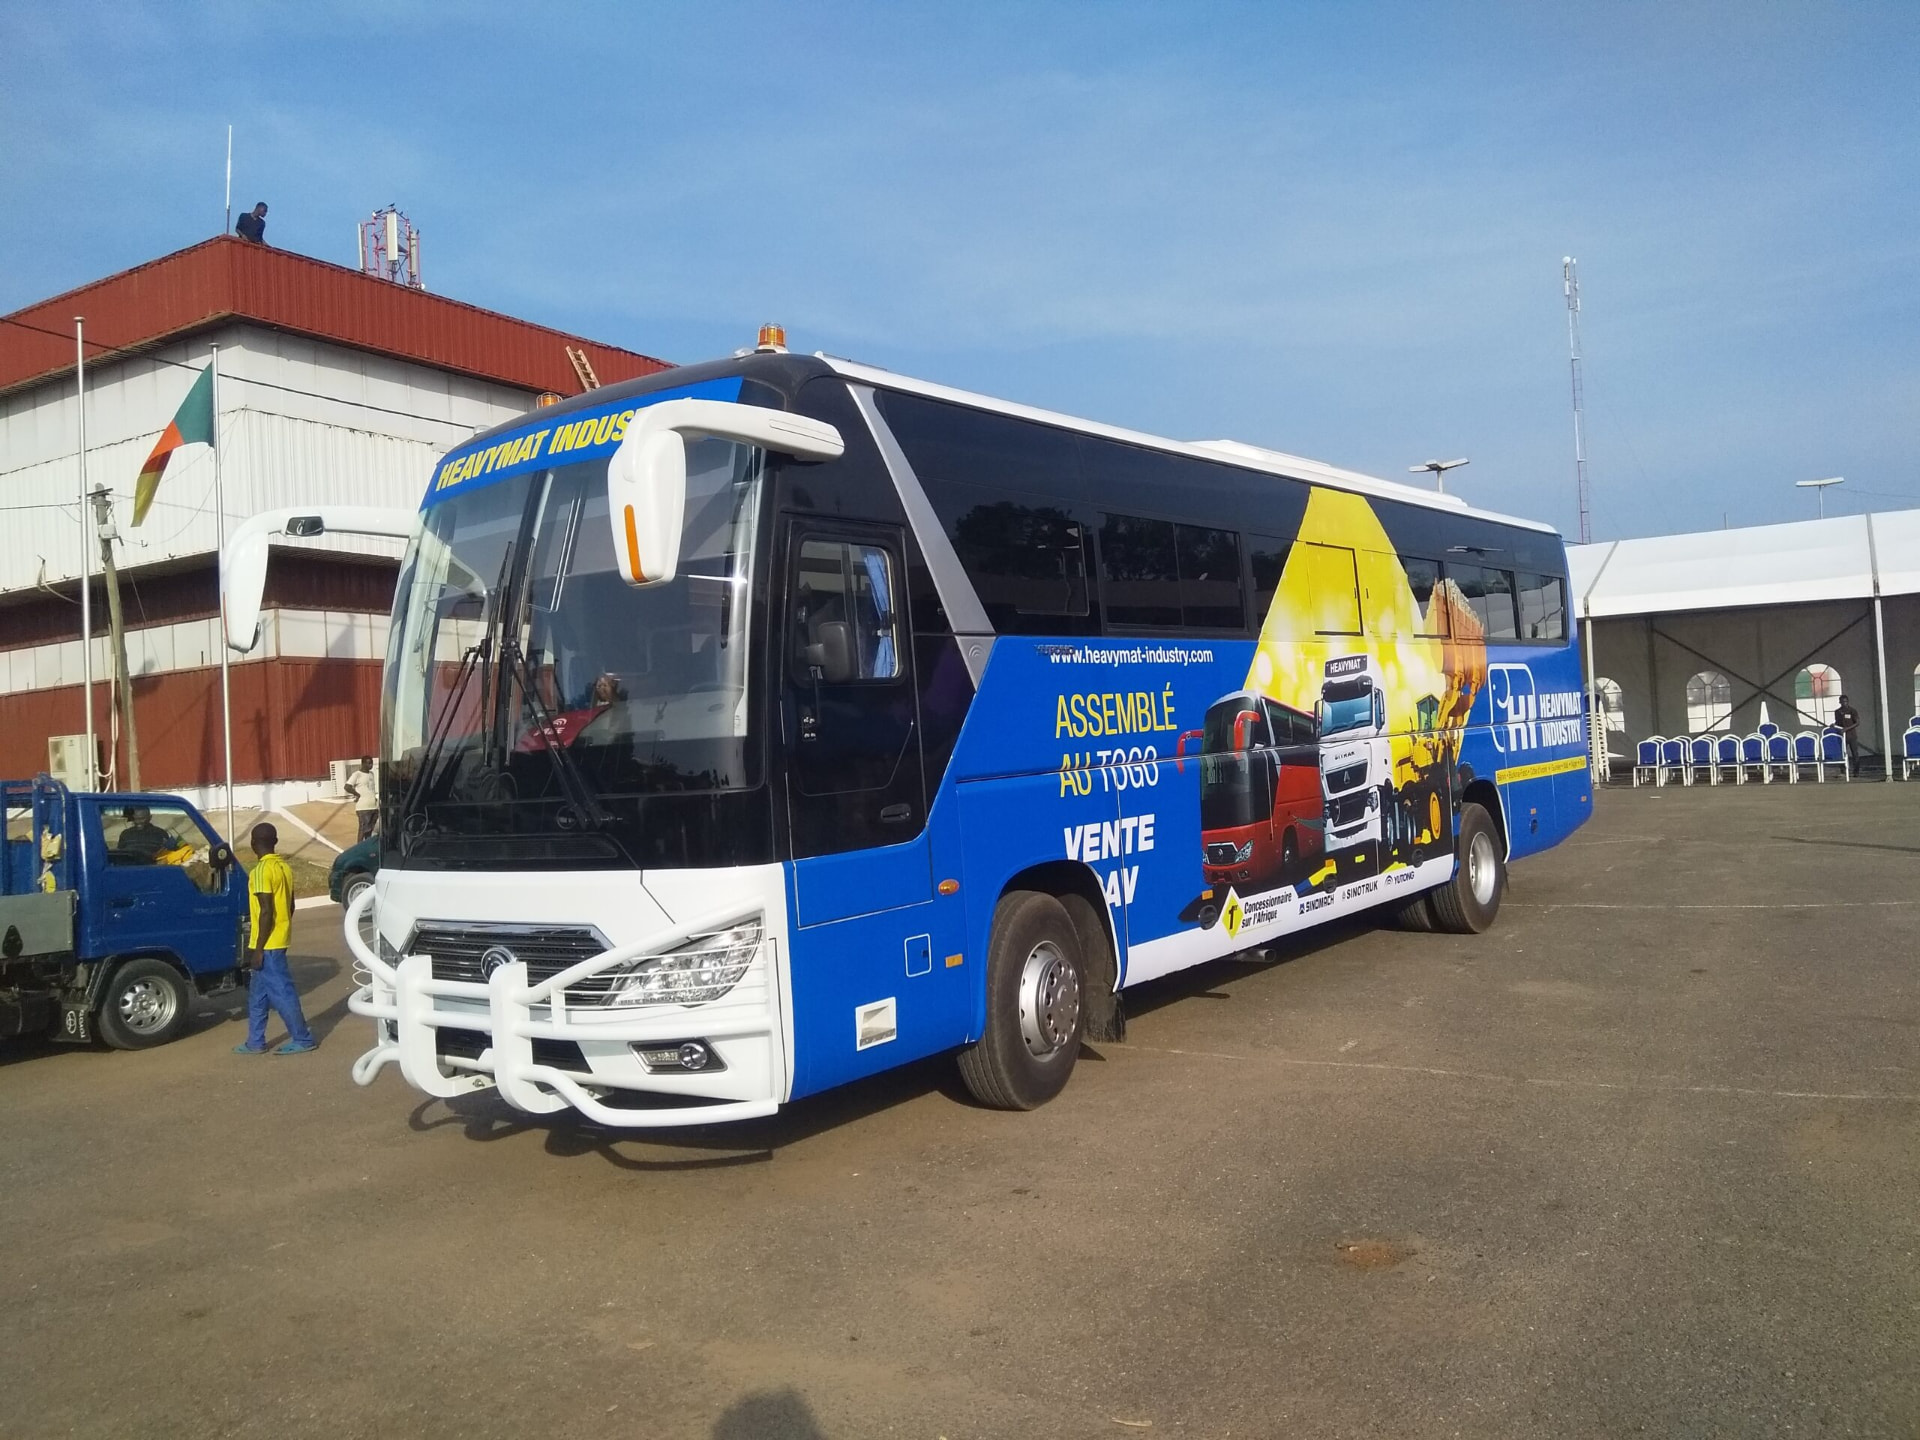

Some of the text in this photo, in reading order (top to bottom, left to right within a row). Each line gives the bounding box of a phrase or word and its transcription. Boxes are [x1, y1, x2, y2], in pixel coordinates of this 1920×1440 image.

[435, 410, 637, 492] HEAVYMAT INDUS
[1050, 645, 1213, 667] www.heavymat-industry.com
[1330, 659, 1361, 674] HEAVYMAT
[1056, 682, 1177, 738] ASSEMBLÉ
[1539, 691, 1581, 718] HEAVYMAT
[1540, 719, 1581, 748] INDUSTRY
[1060, 745, 1159, 798] AU TOGO
[1063, 813, 1155, 863] VENTE
[1098, 865, 1139, 907] AV
[1346, 880, 1378, 899] SINOTRUK
[1394, 871, 1415, 885] YUTONG
[1244, 891, 1292, 914] Concessionnaire
[1241, 909, 1278, 929] sur l'Afrique
